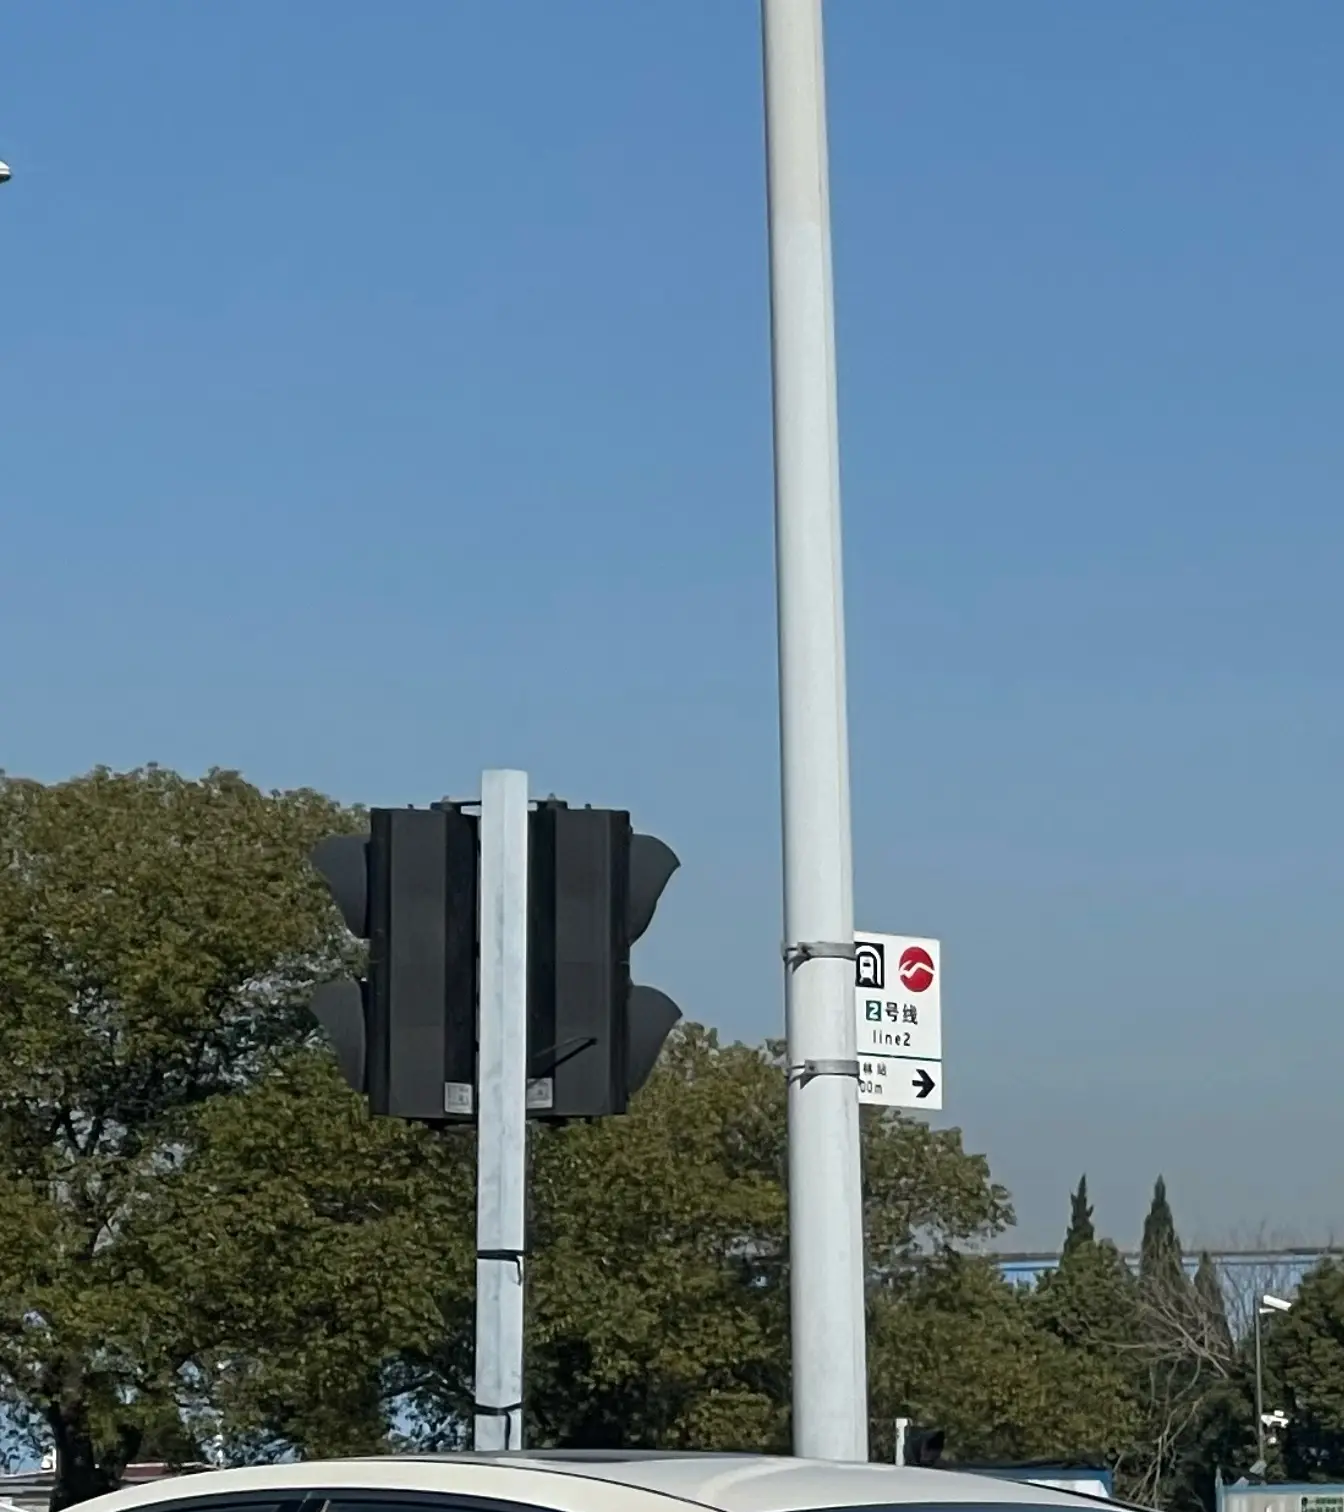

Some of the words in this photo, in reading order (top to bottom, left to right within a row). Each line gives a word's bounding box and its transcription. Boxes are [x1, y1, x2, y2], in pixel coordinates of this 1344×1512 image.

[866, 1000, 918, 1025] 2号线
[872, 1030, 911, 1046] line2
[862, 1063, 888, 1077] 林站
[859, 1080, 883, 1094] 00m
